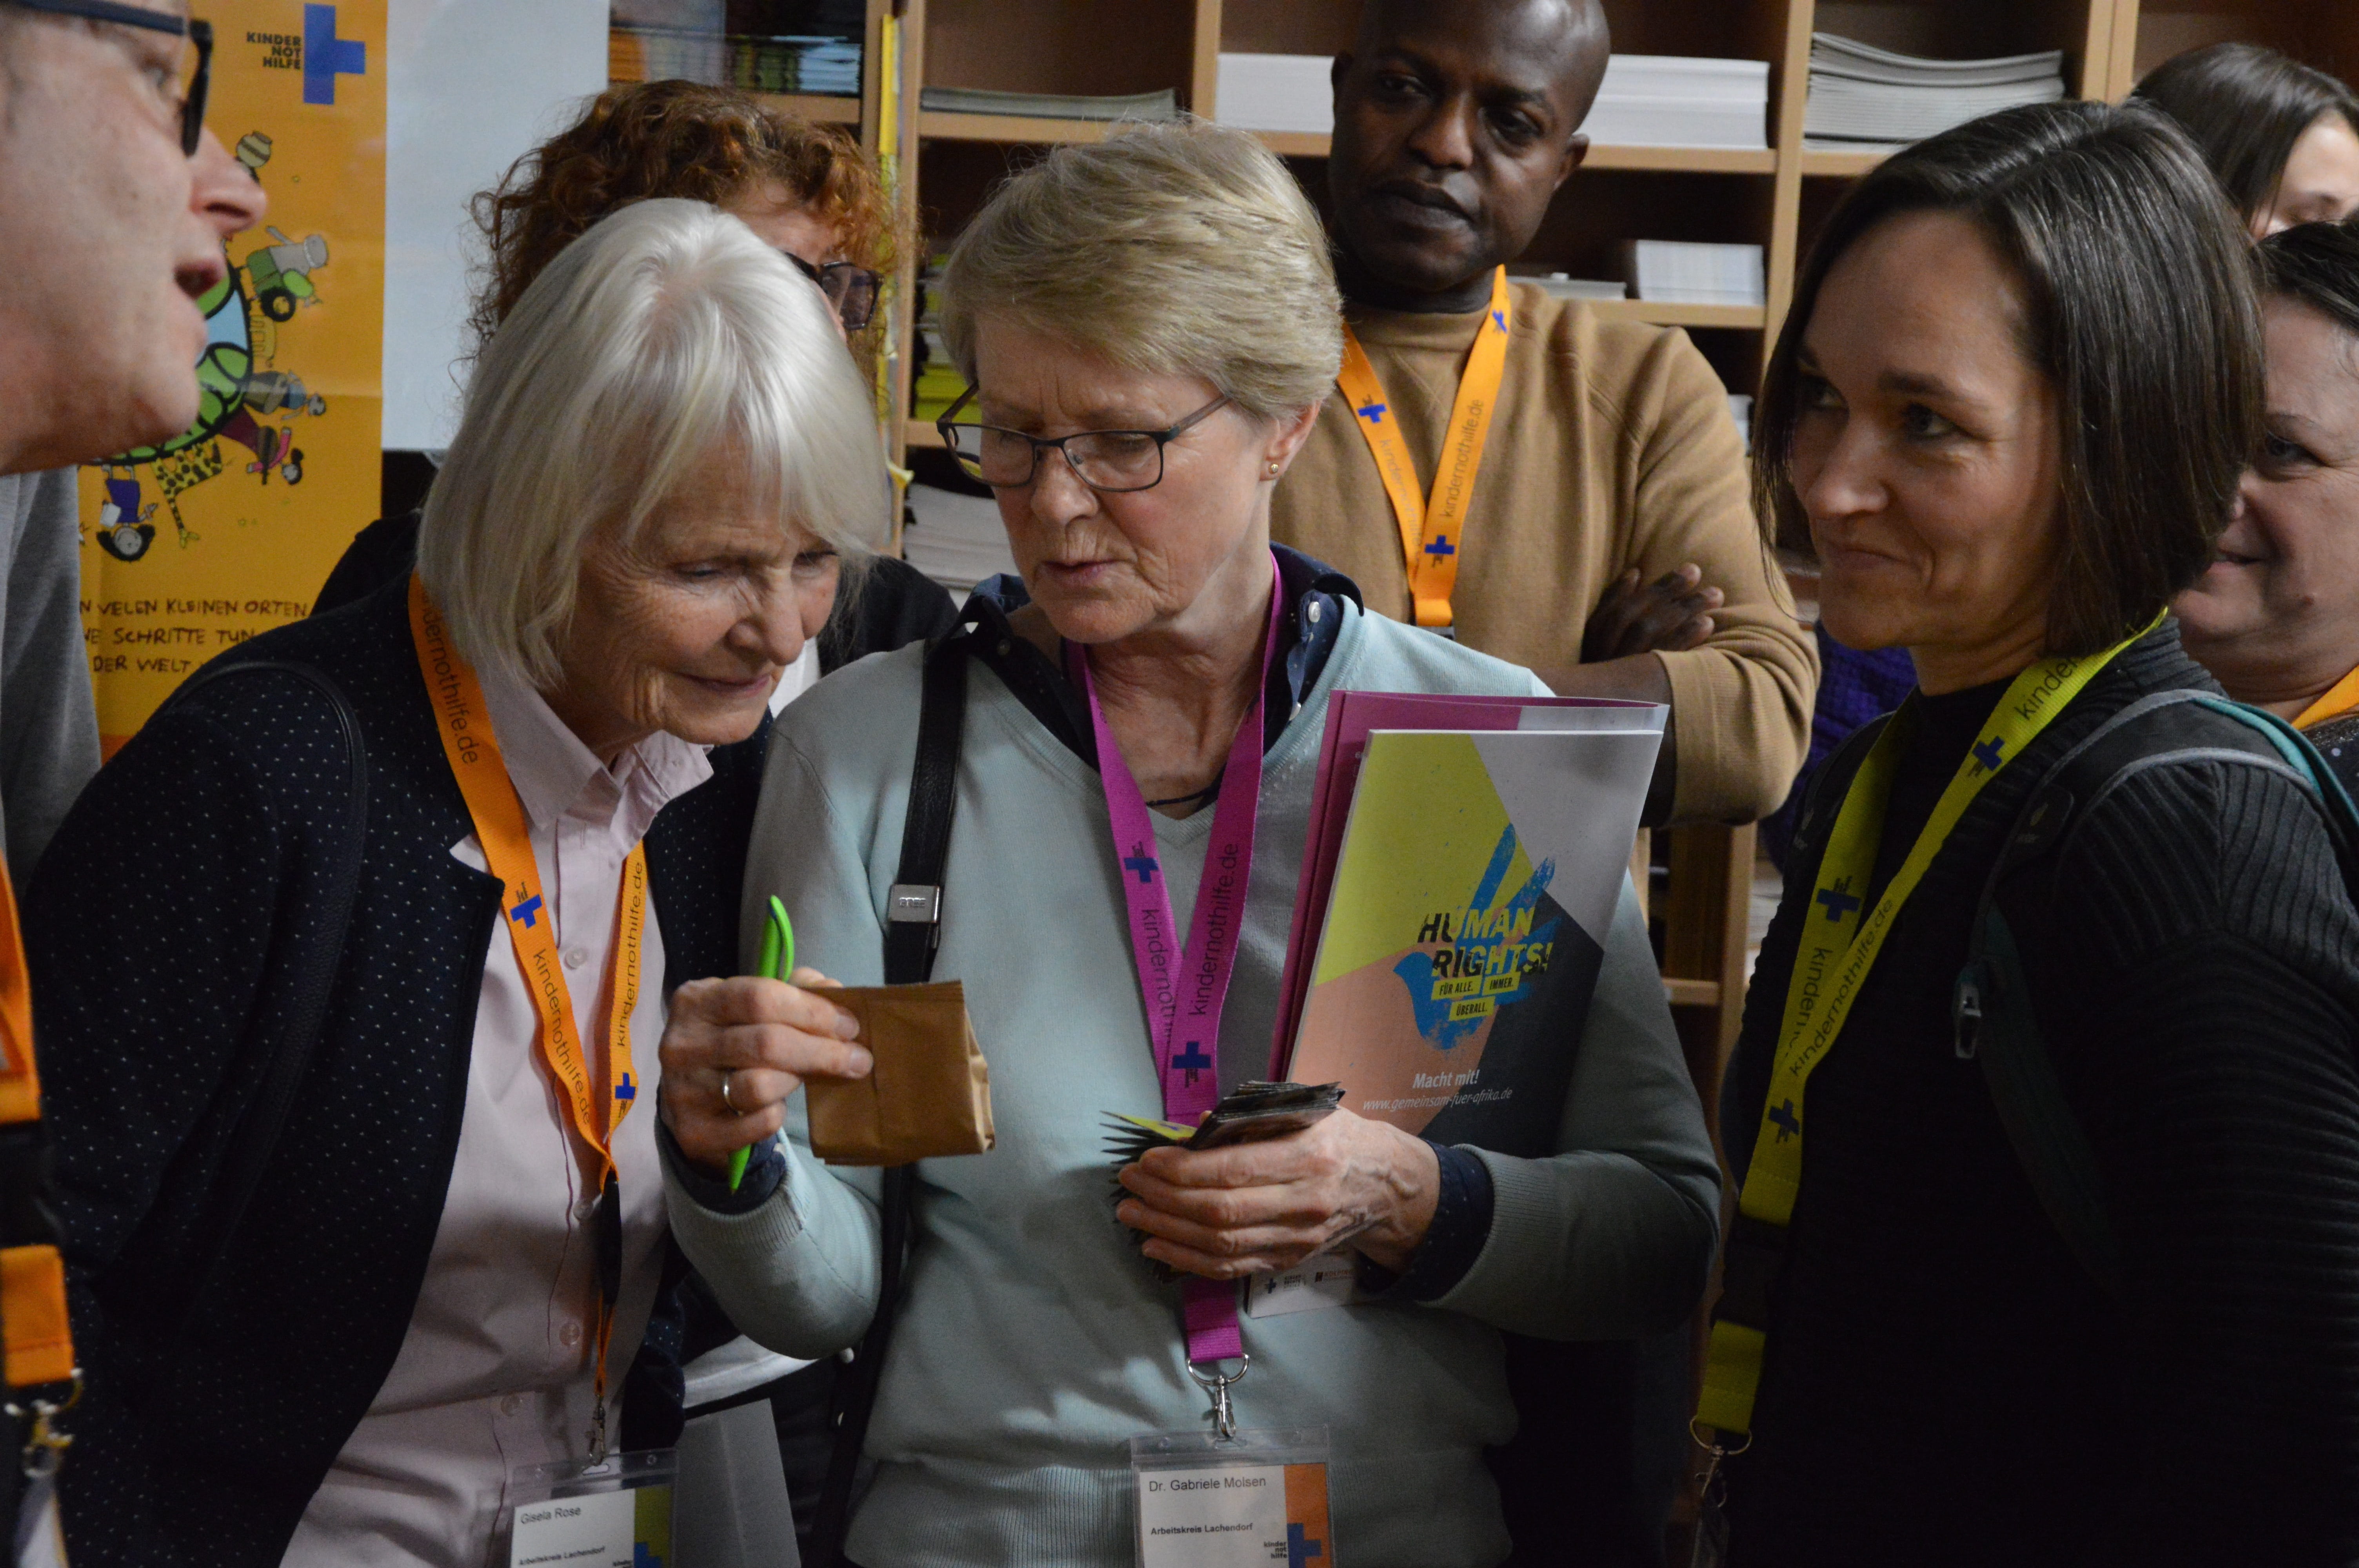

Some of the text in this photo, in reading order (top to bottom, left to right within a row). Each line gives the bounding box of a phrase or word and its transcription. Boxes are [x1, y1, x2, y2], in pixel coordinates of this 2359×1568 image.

[246, 31, 301, 47] KINDER
[271, 46, 301, 58] NOT
[262, 57, 301, 70] HILFE
[1442, 398, 1485, 518] kindernothilfe.de
[167, 598, 238, 615] KLEINEN
[244, 599, 307, 617] ORTEN
[113, 626, 205, 644] SCHRITTE
[93, 654, 192, 673] DER WELT
[1188, 842, 1239, 1016] kindernothilfe.de
[1417, 907, 1536, 943] HUMAN
[616, 862, 643, 1047] kindernothilfe.de
[1432, 942, 1554, 978] RIGHTS!
[1439, 977, 1514, 996] FÜR ALLE. IMMER.
[1789, 899, 1893, 1077] kindernothilfe.de
[1456, 1002, 1488, 1016] ÜBERALL.
[533, 949, 591, 1125] kindernothilfe.de
[1412, 1069, 1481, 1089] Macht mit!
[1363, 1087, 1513, 1112] www.gemeinsam-fuer-afrika.de
[1149, 1481, 1166, 1492] Dr.
[1170, 1478, 1220, 1491] Gabriele
[520, 1506, 582, 1524] Gisela Rose
[1150, 1522, 1254, 1535] Arbeitskreis Lachendorf
